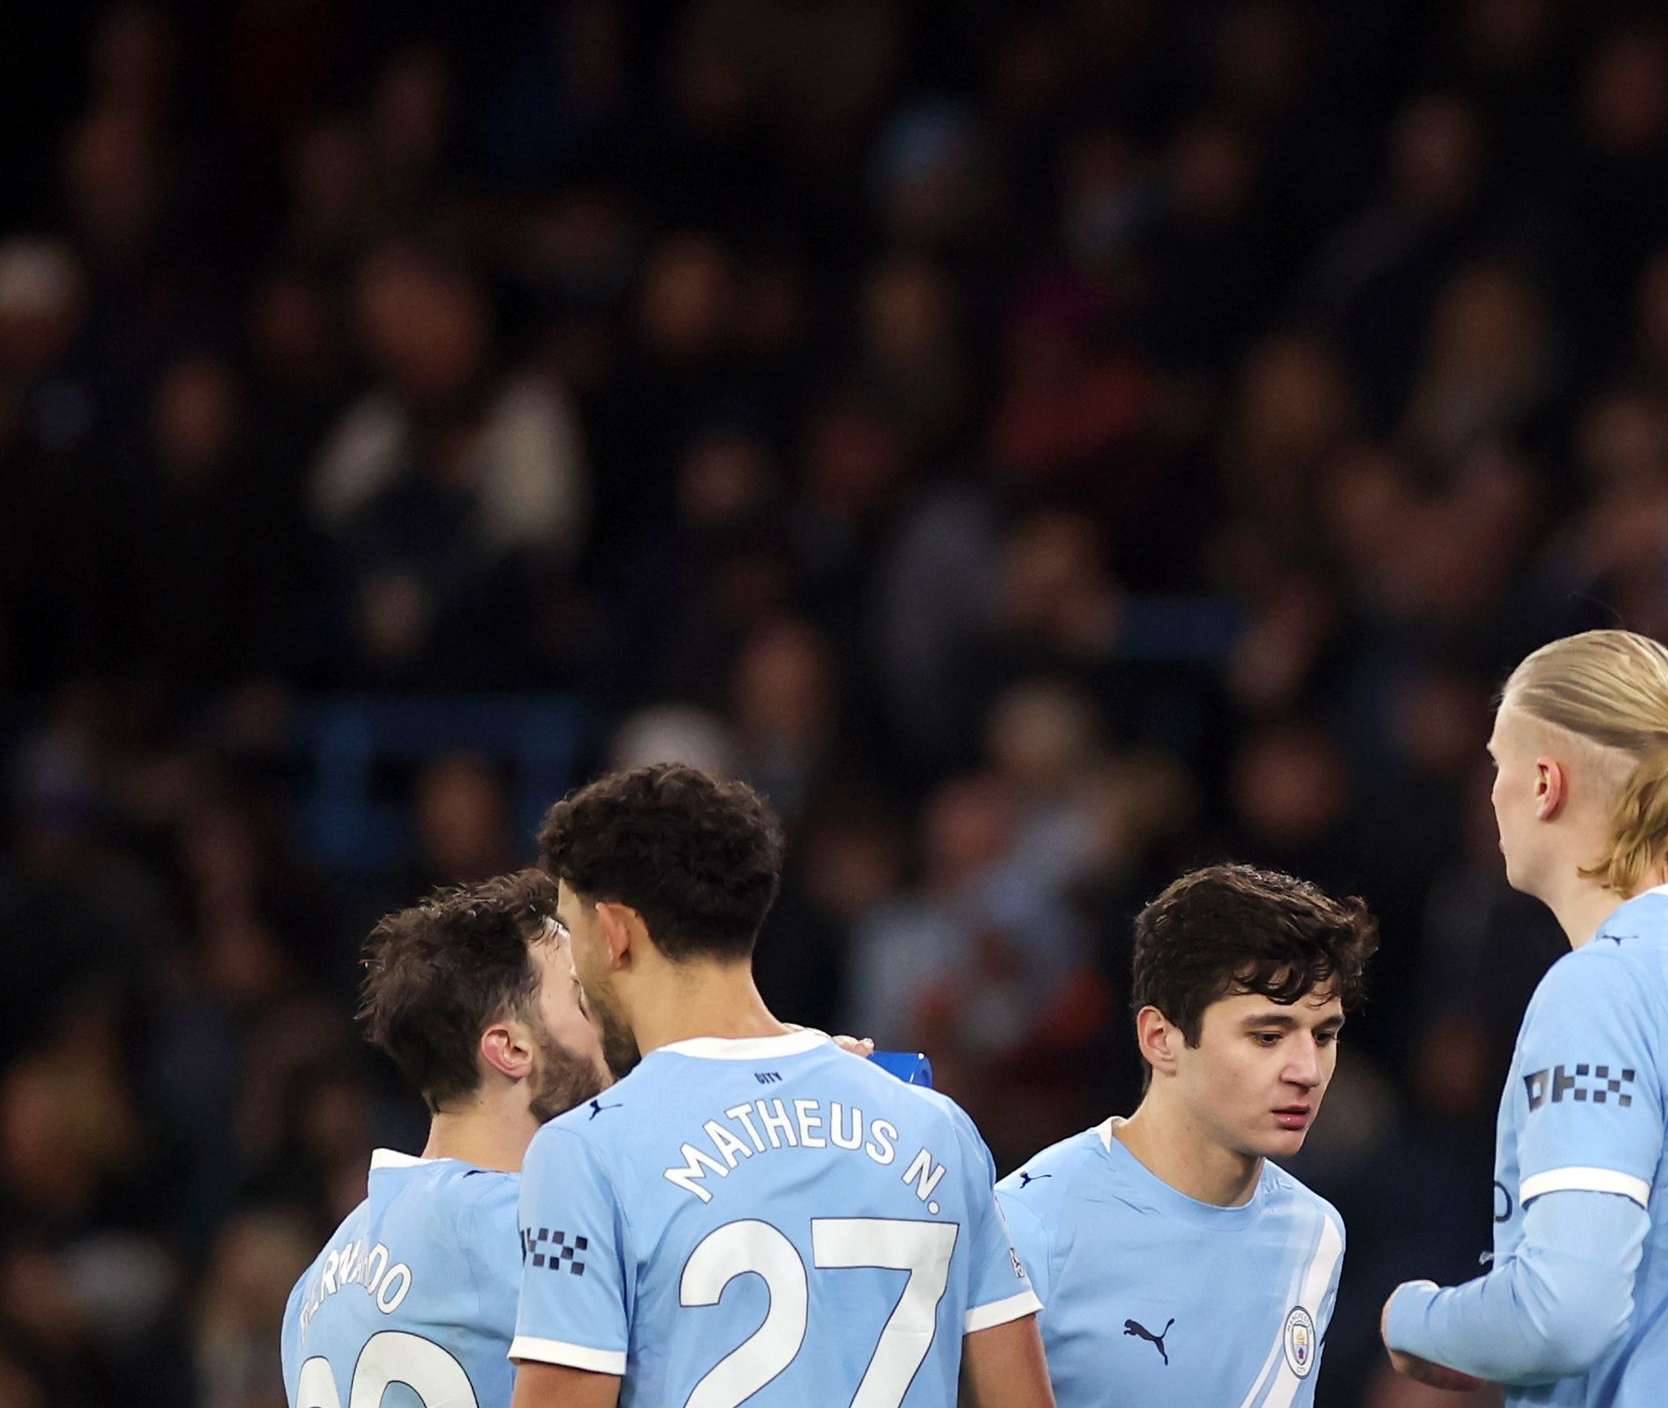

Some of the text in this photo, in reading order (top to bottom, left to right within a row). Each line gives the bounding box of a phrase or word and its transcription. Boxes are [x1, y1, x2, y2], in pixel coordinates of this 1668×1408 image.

[754, 1071, 783, 1085] CITY
[662, 1097, 948, 1216] MATHEUS N.
